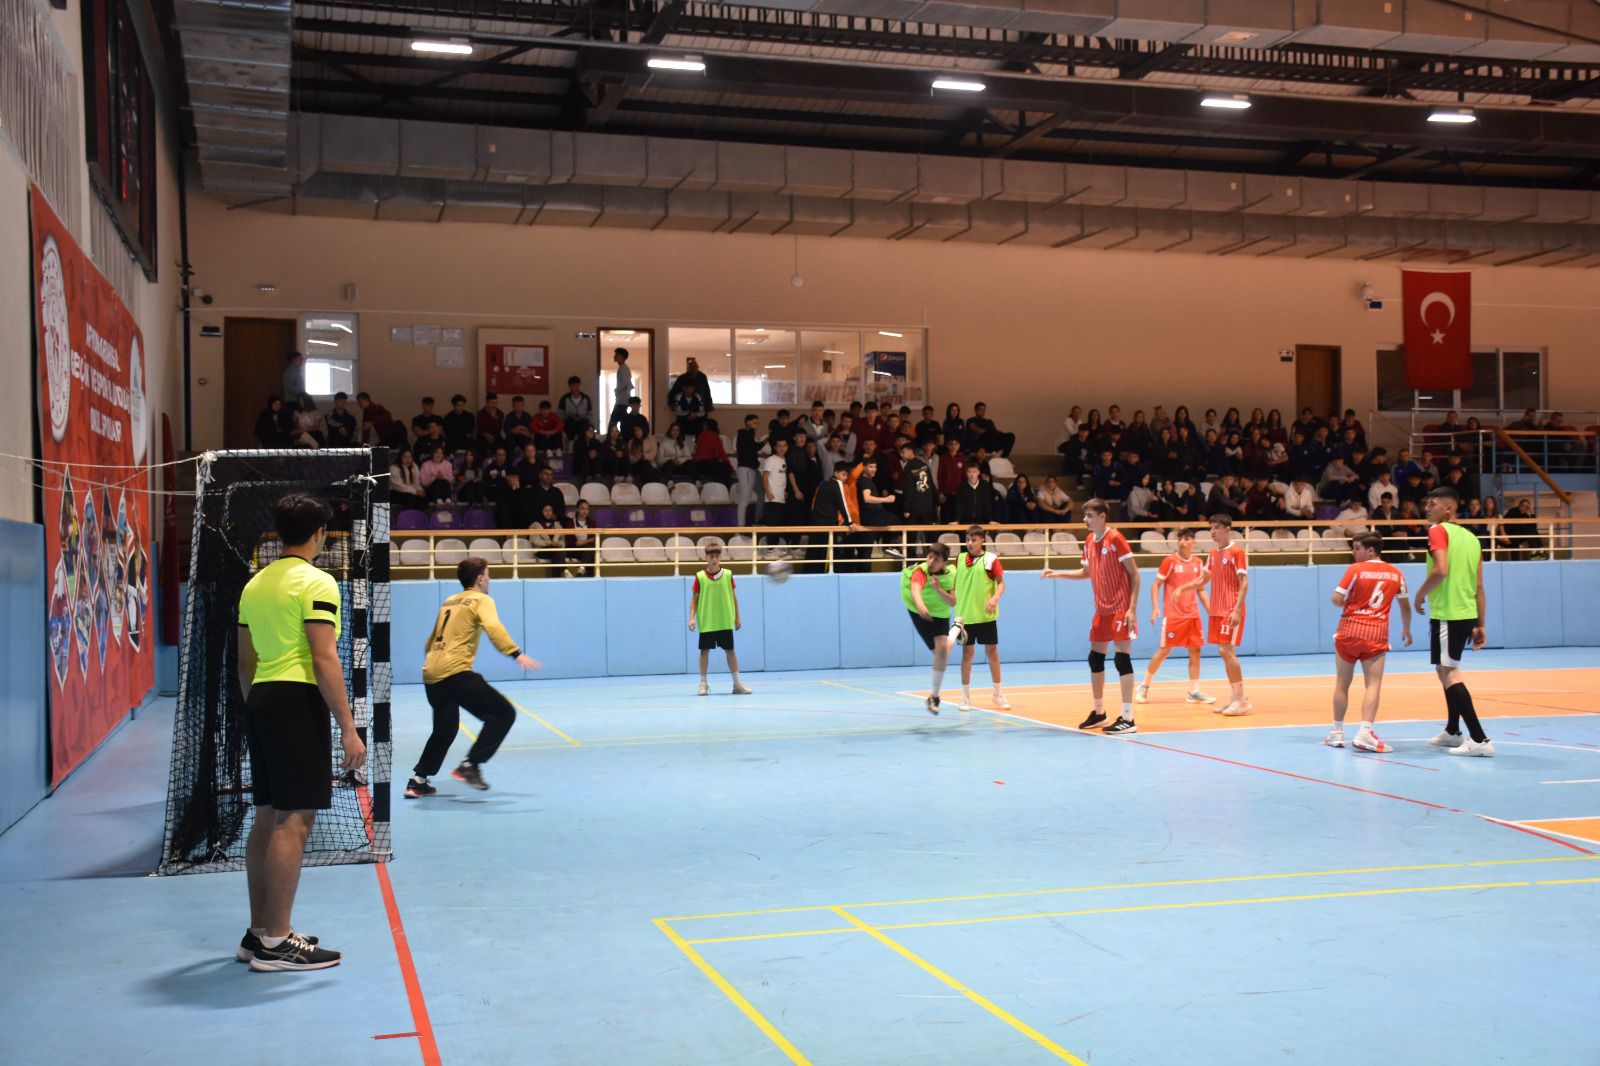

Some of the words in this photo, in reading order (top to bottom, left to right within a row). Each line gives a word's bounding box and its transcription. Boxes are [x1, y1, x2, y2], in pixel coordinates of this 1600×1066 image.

[1368, 580, 1384, 608] 6
[436, 608, 450, 642] 1
[1115, 620, 1123, 632] 7
